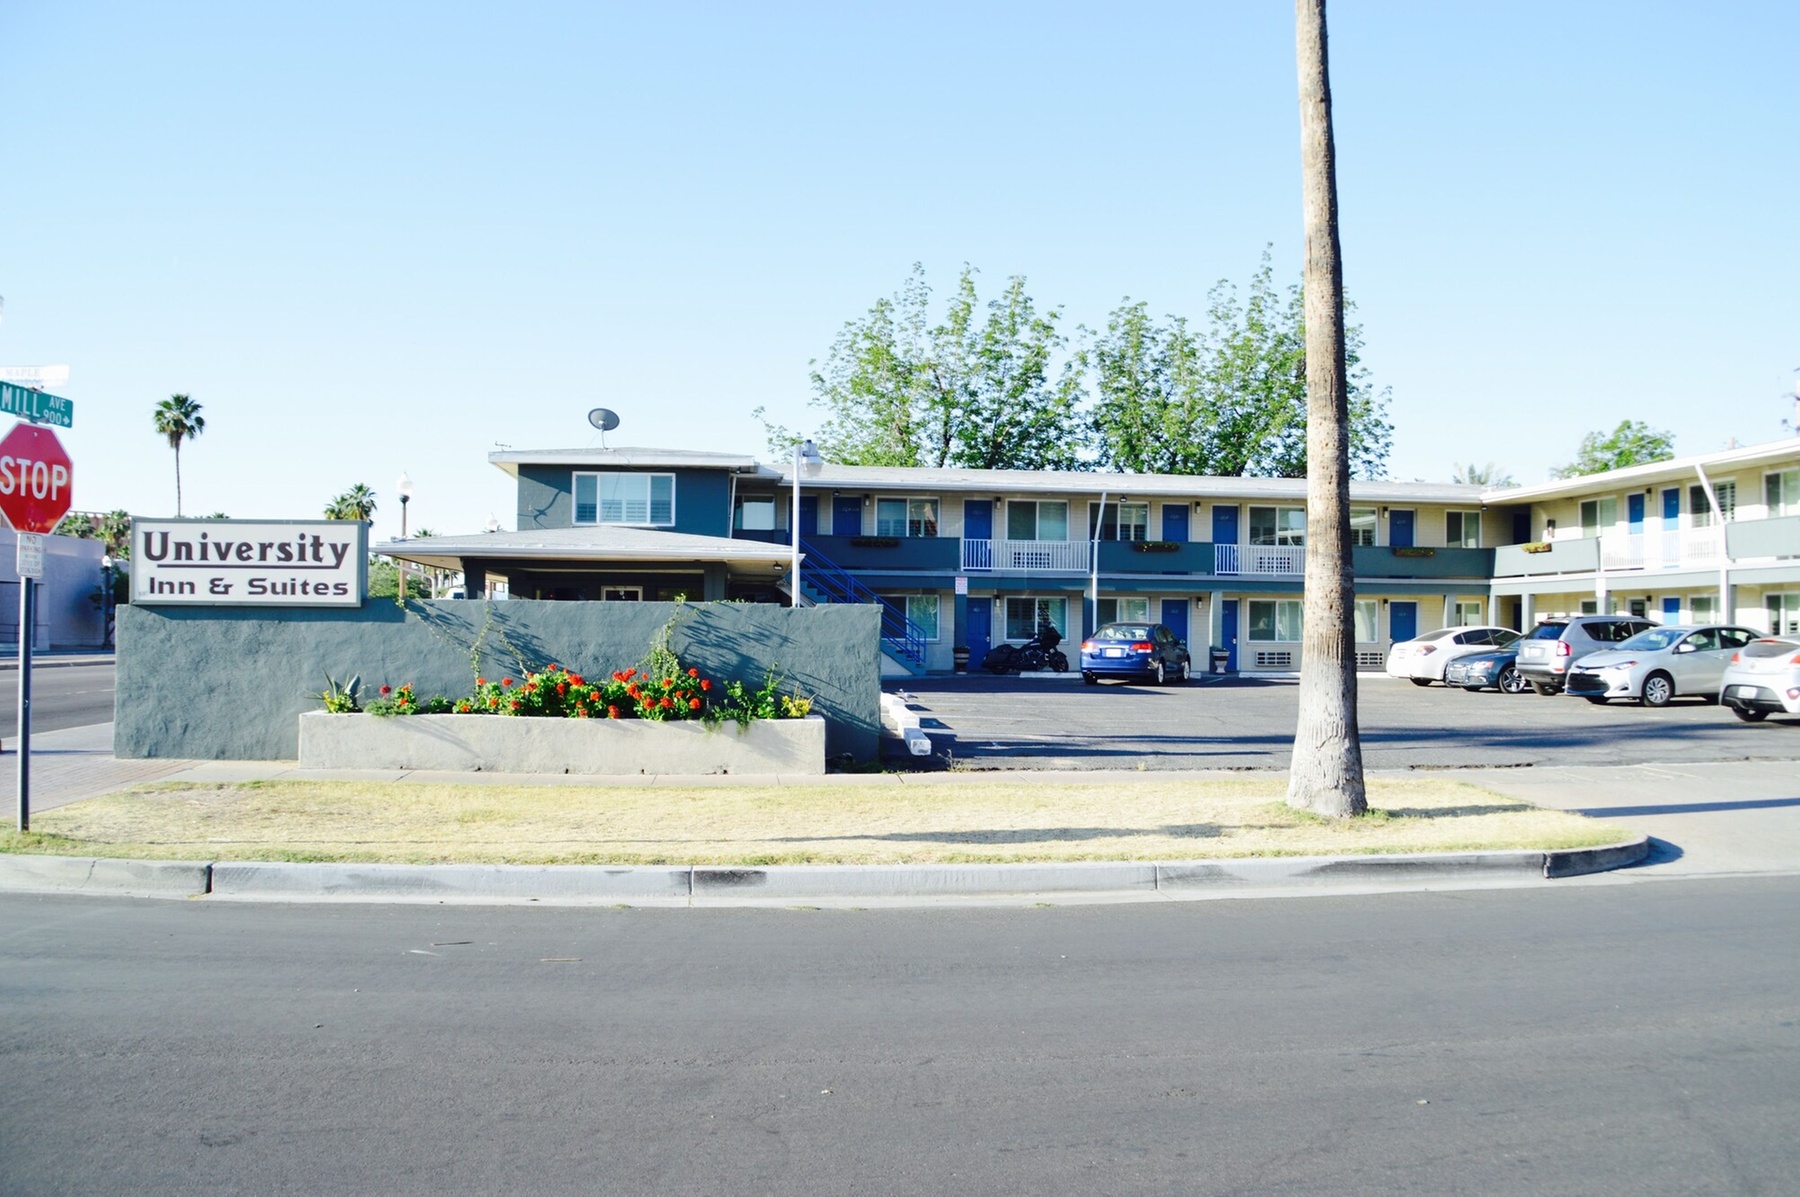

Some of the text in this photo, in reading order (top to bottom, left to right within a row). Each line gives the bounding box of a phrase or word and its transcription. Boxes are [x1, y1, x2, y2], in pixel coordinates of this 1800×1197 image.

[1, 385, 66, 417] MILL AVE
[43, 409, 62, 425] 900
[0, 455, 68, 501] STOP
[26, 535, 36, 545] NO
[142, 531, 351, 569] University
[149, 577, 349, 595] Inn & Suites
